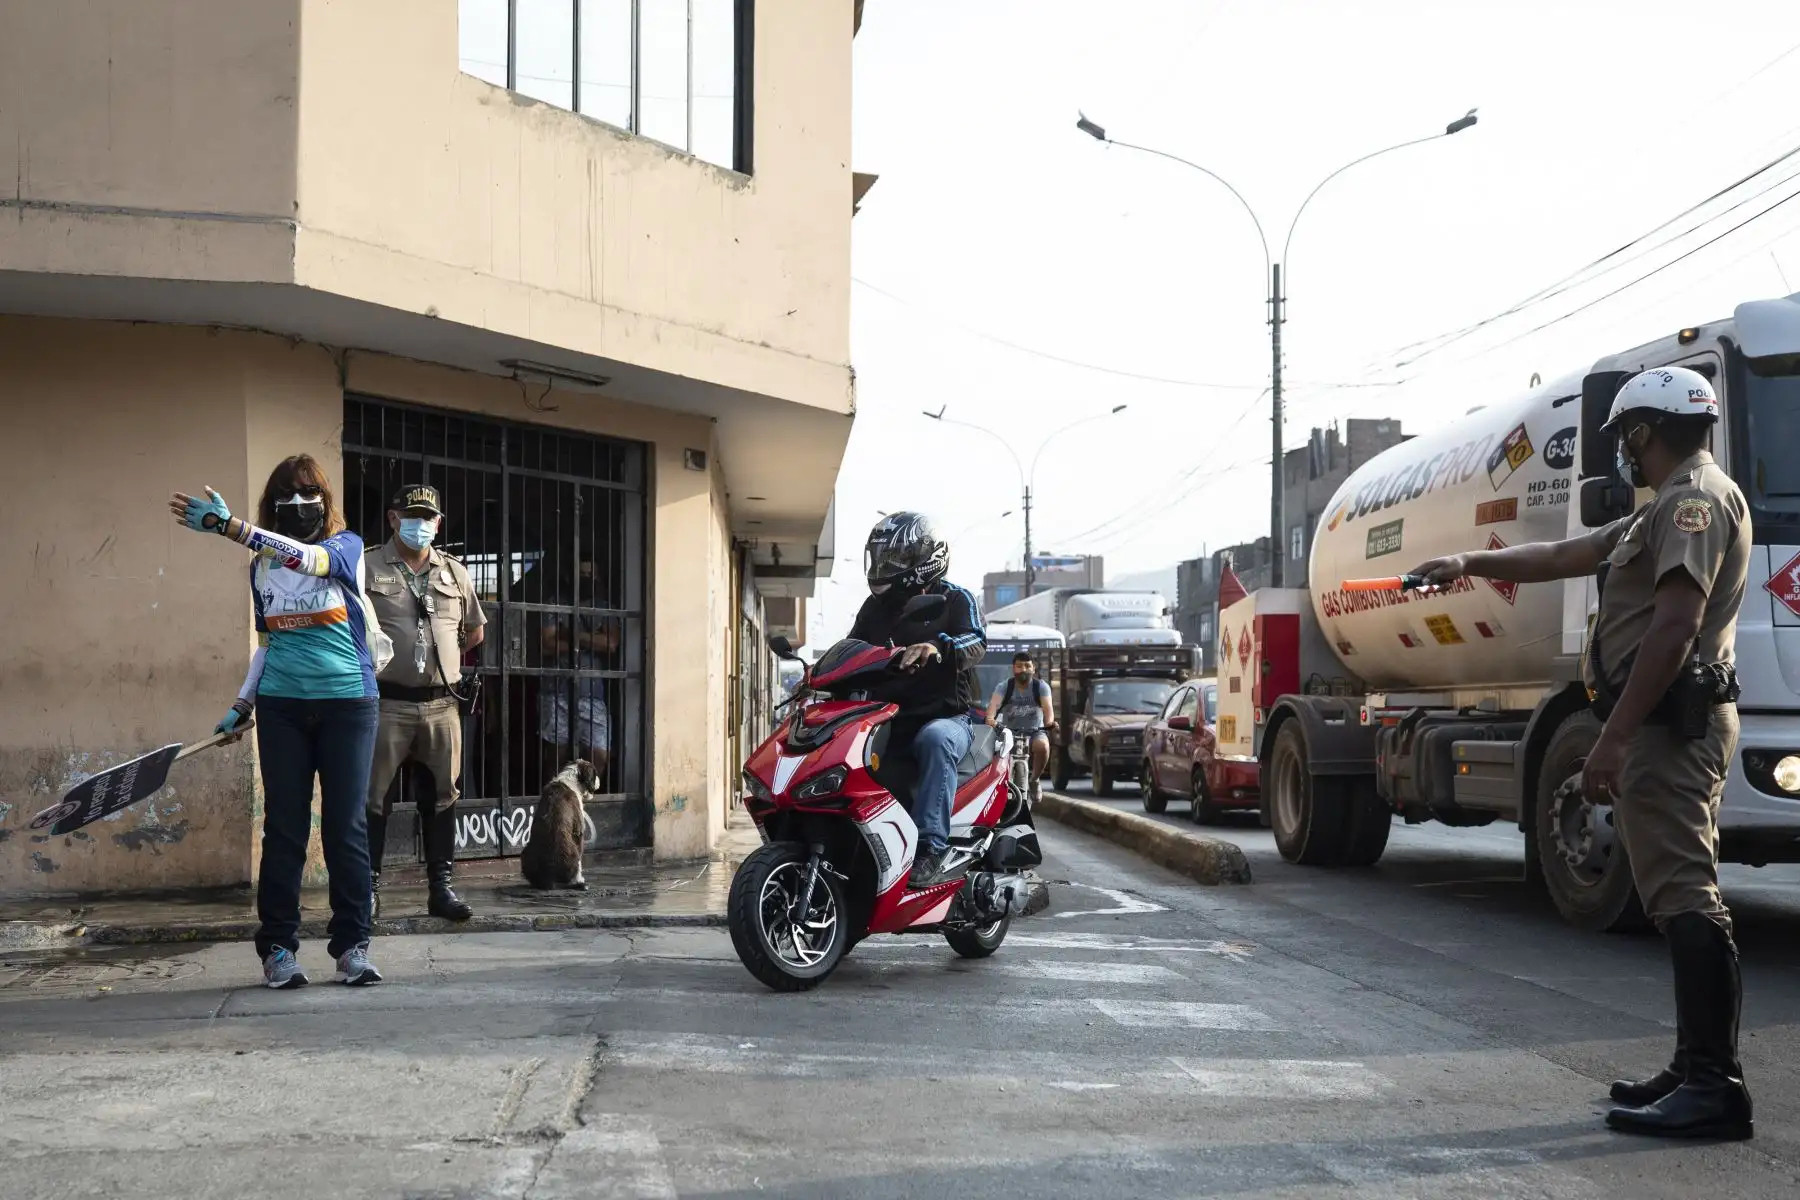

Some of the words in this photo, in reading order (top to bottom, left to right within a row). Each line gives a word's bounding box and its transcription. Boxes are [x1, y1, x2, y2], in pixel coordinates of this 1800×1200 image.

[1507, 428, 1524, 447] 4
[1514, 445, 1526, 462] 0
[1528, 478, 1571, 493] HD-60
[1527, 494, 1545, 507] CAP.
[1548, 491, 1570, 505] 3,00
[260, 535, 299, 556] CICLOLIMA
[282, 592, 336, 612] LIMA
[1321, 588, 1341, 617] GAS
[276, 616, 314, 630] LÍDER
